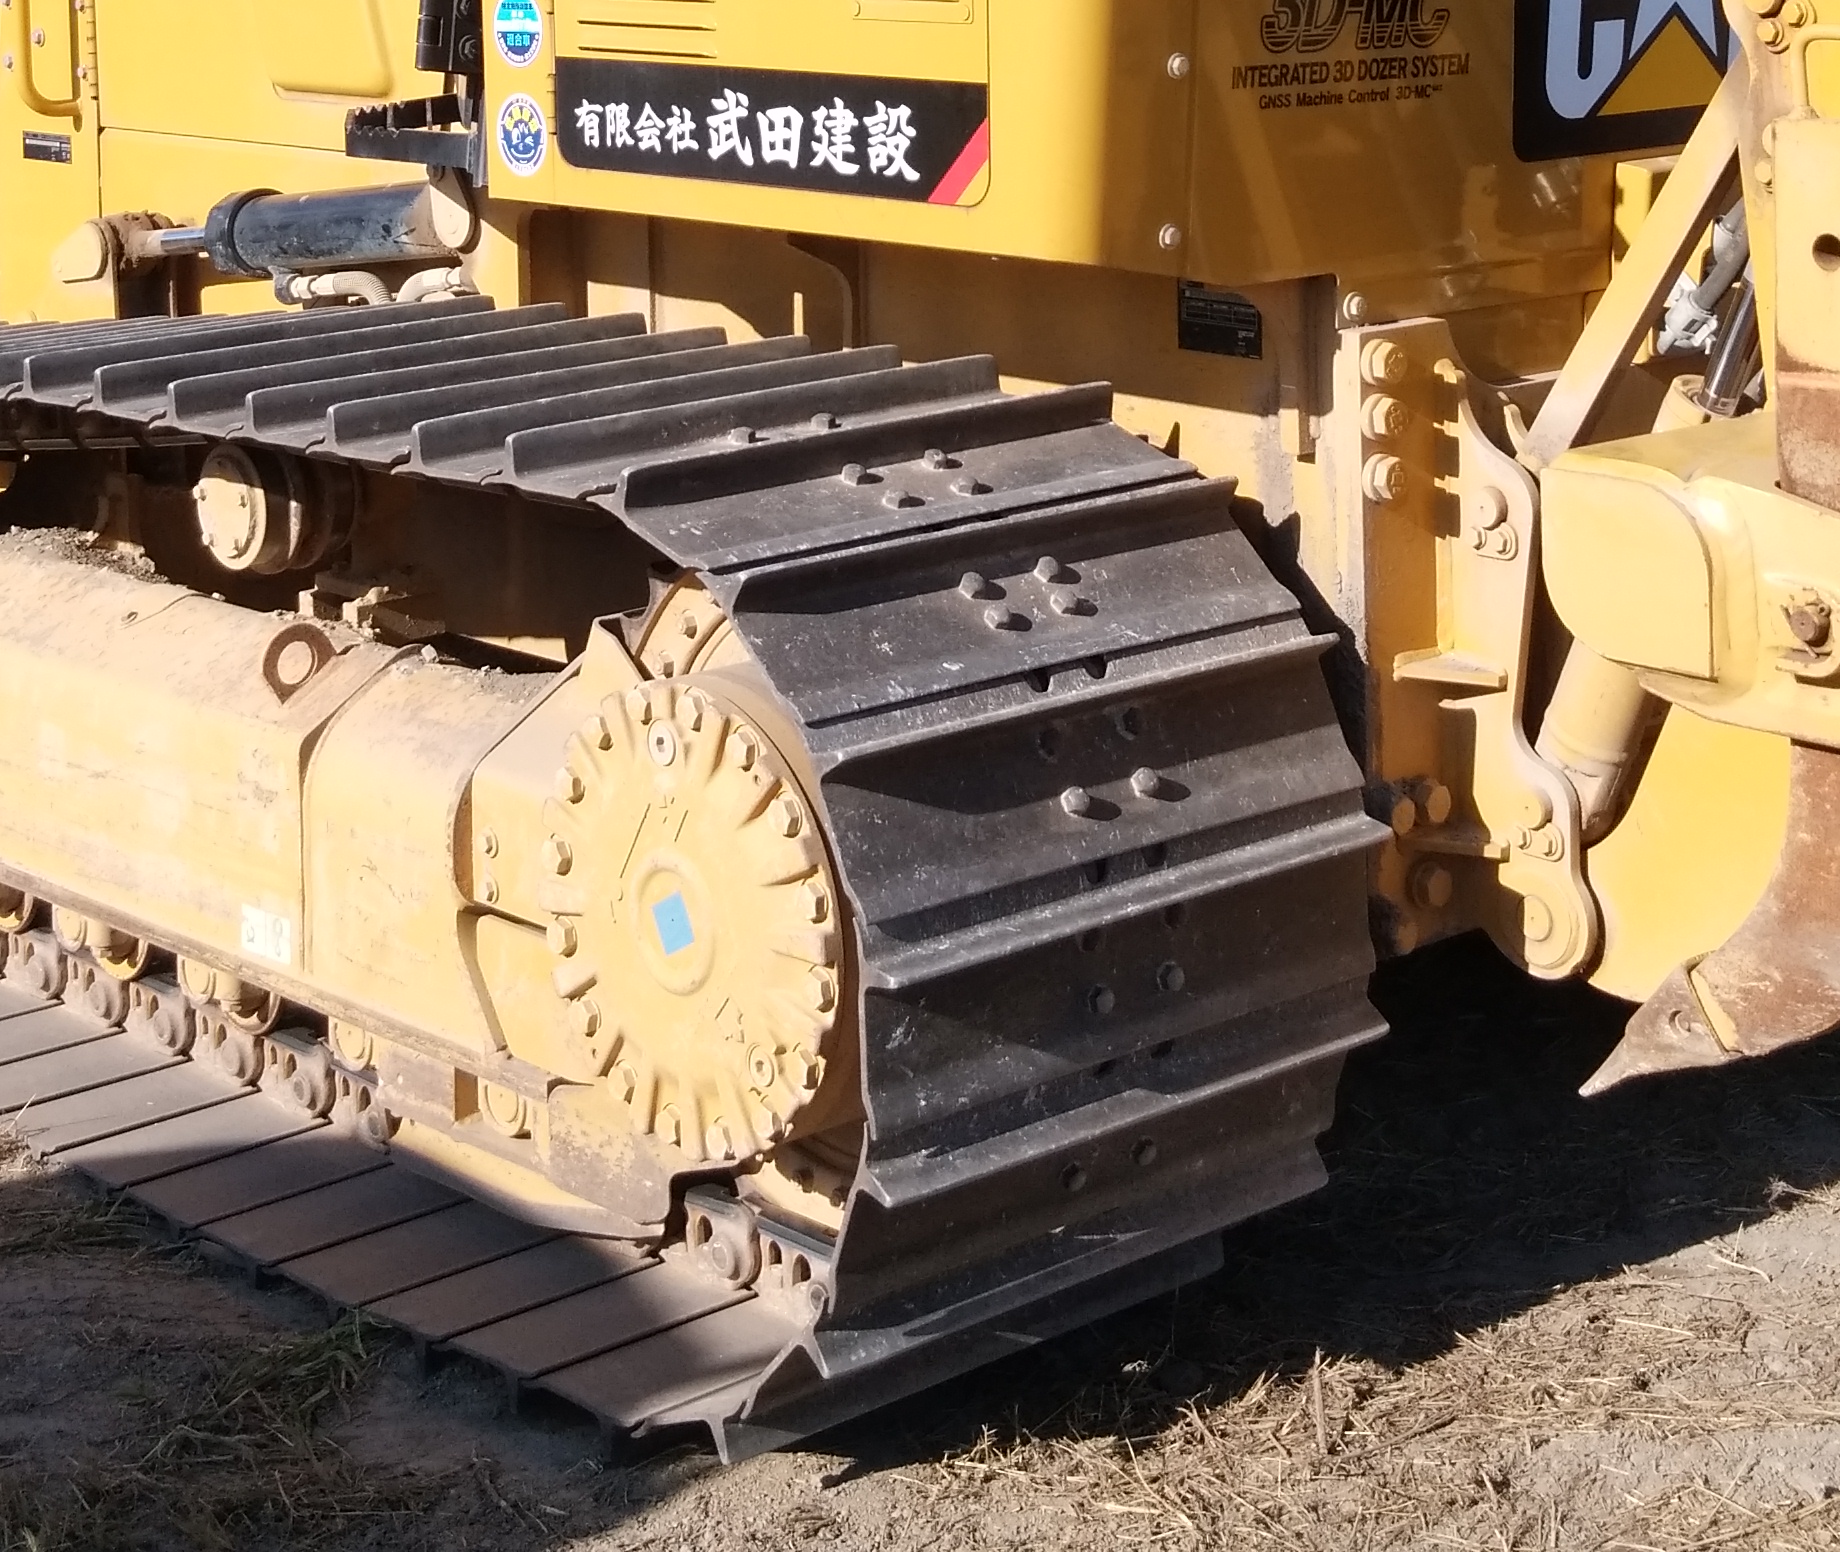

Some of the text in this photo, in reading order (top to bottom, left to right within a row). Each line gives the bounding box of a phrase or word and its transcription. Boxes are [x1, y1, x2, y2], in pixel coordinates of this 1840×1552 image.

[1231, 53, 1470, 89] INTEGRATED 3D DOZER SYSTEM
[1259, 94, 1291, 110] GNSS
[1295, 91, 1343, 108] Machine
[1348, 87, 1389, 104] Control
